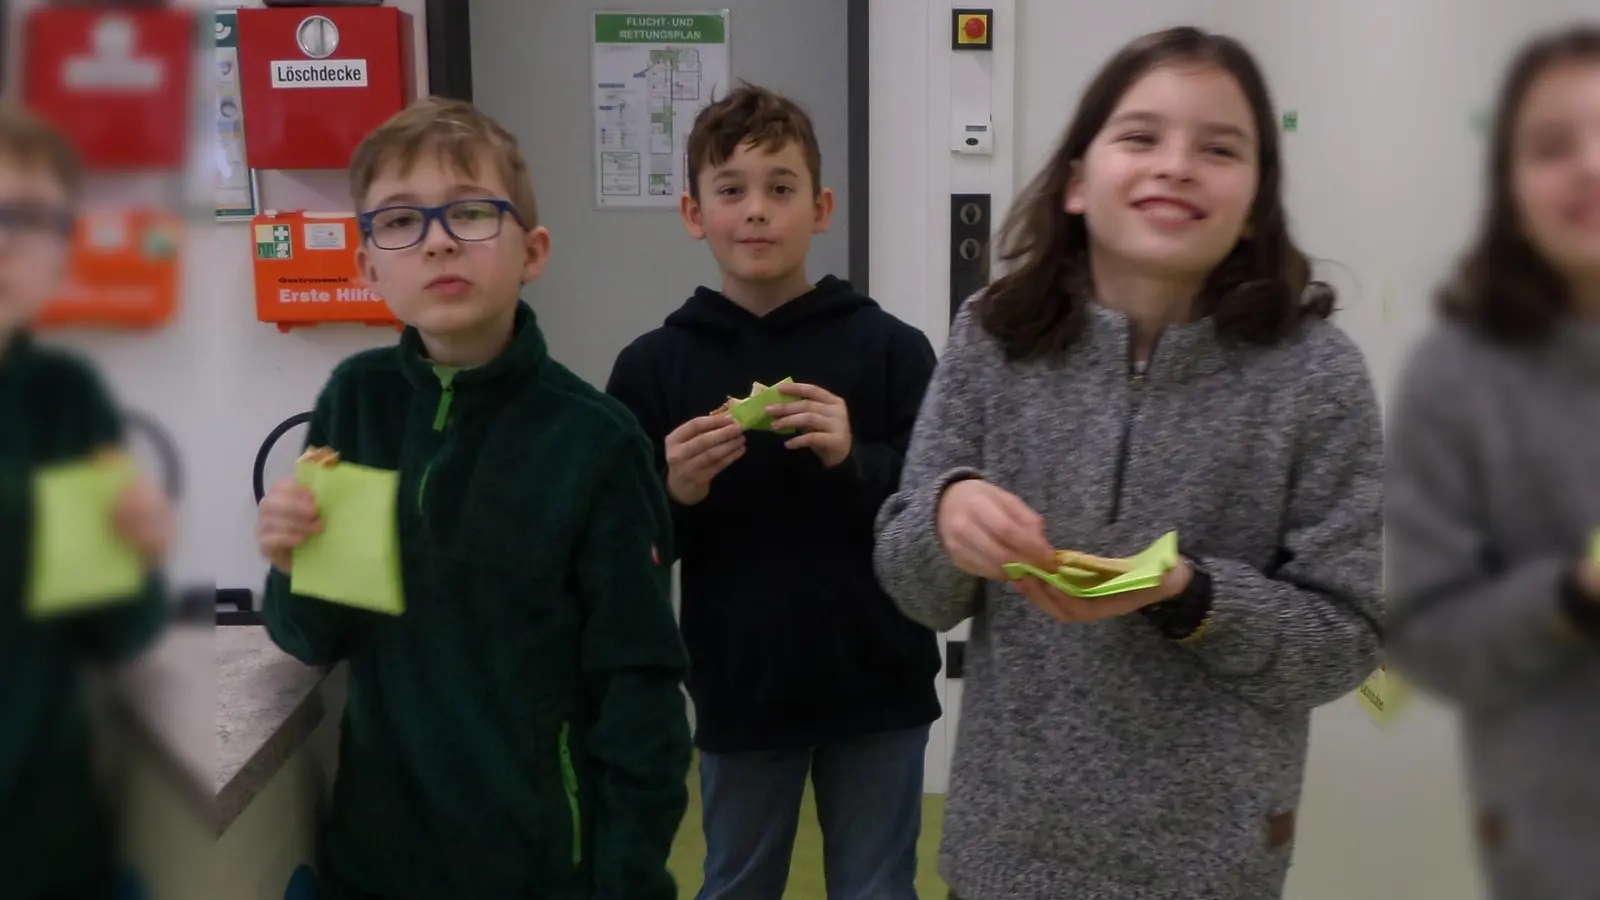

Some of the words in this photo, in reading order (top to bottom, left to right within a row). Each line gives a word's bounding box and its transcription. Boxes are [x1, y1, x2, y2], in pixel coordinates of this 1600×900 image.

[626, 17, 670, 27] FLUCHT-
[672, 17, 694, 27] UND
[619, 29, 701, 40] RETTUNGSPLAN
[277, 65, 361, 82] Löschdecke
[278, 276, 349, 284] Gastronomie
[279, 288, 330, 302] Erste
